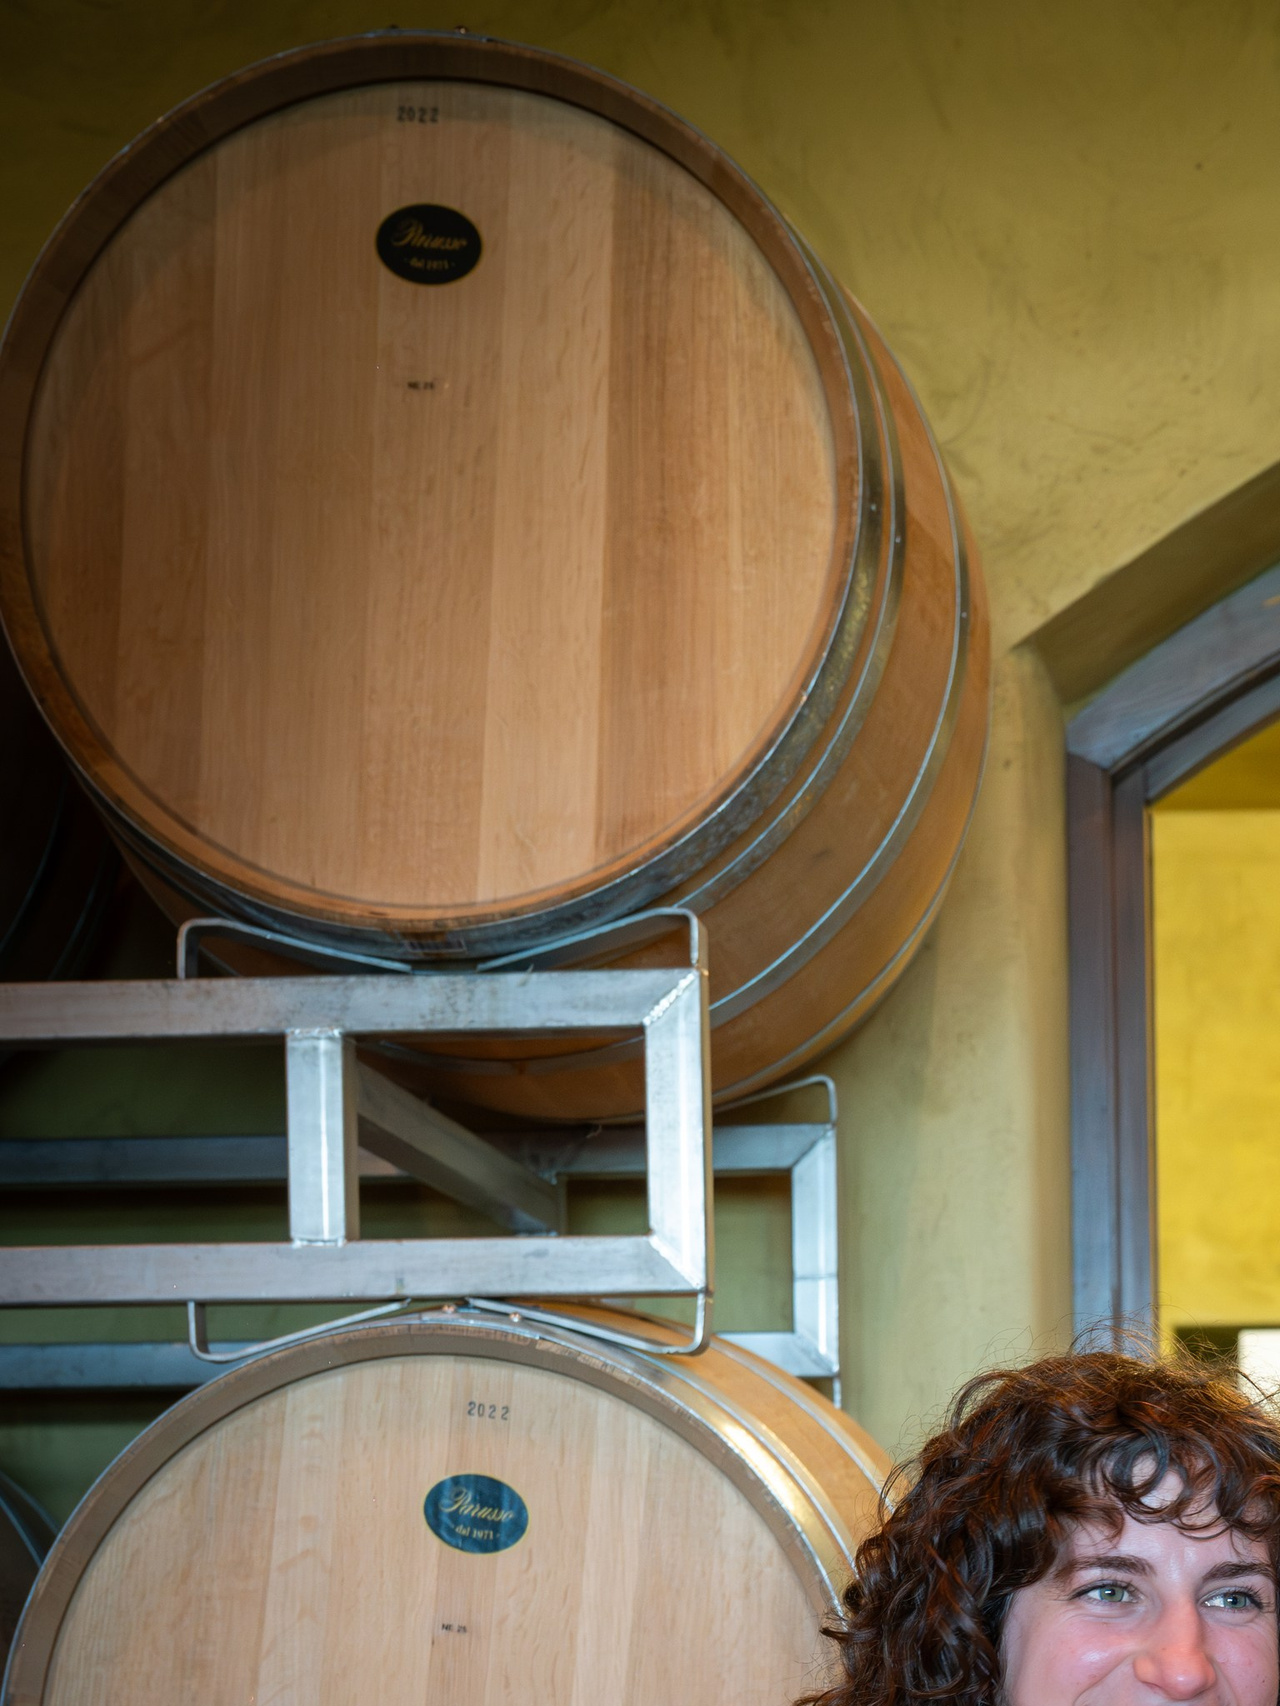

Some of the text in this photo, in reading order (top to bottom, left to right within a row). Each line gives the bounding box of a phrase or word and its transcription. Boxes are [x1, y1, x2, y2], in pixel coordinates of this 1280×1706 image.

[397, 106, 440, 123] 2022
[467, 1401, 510, 1420] 2022
[440, 1488, 514, 1521] Parusso
